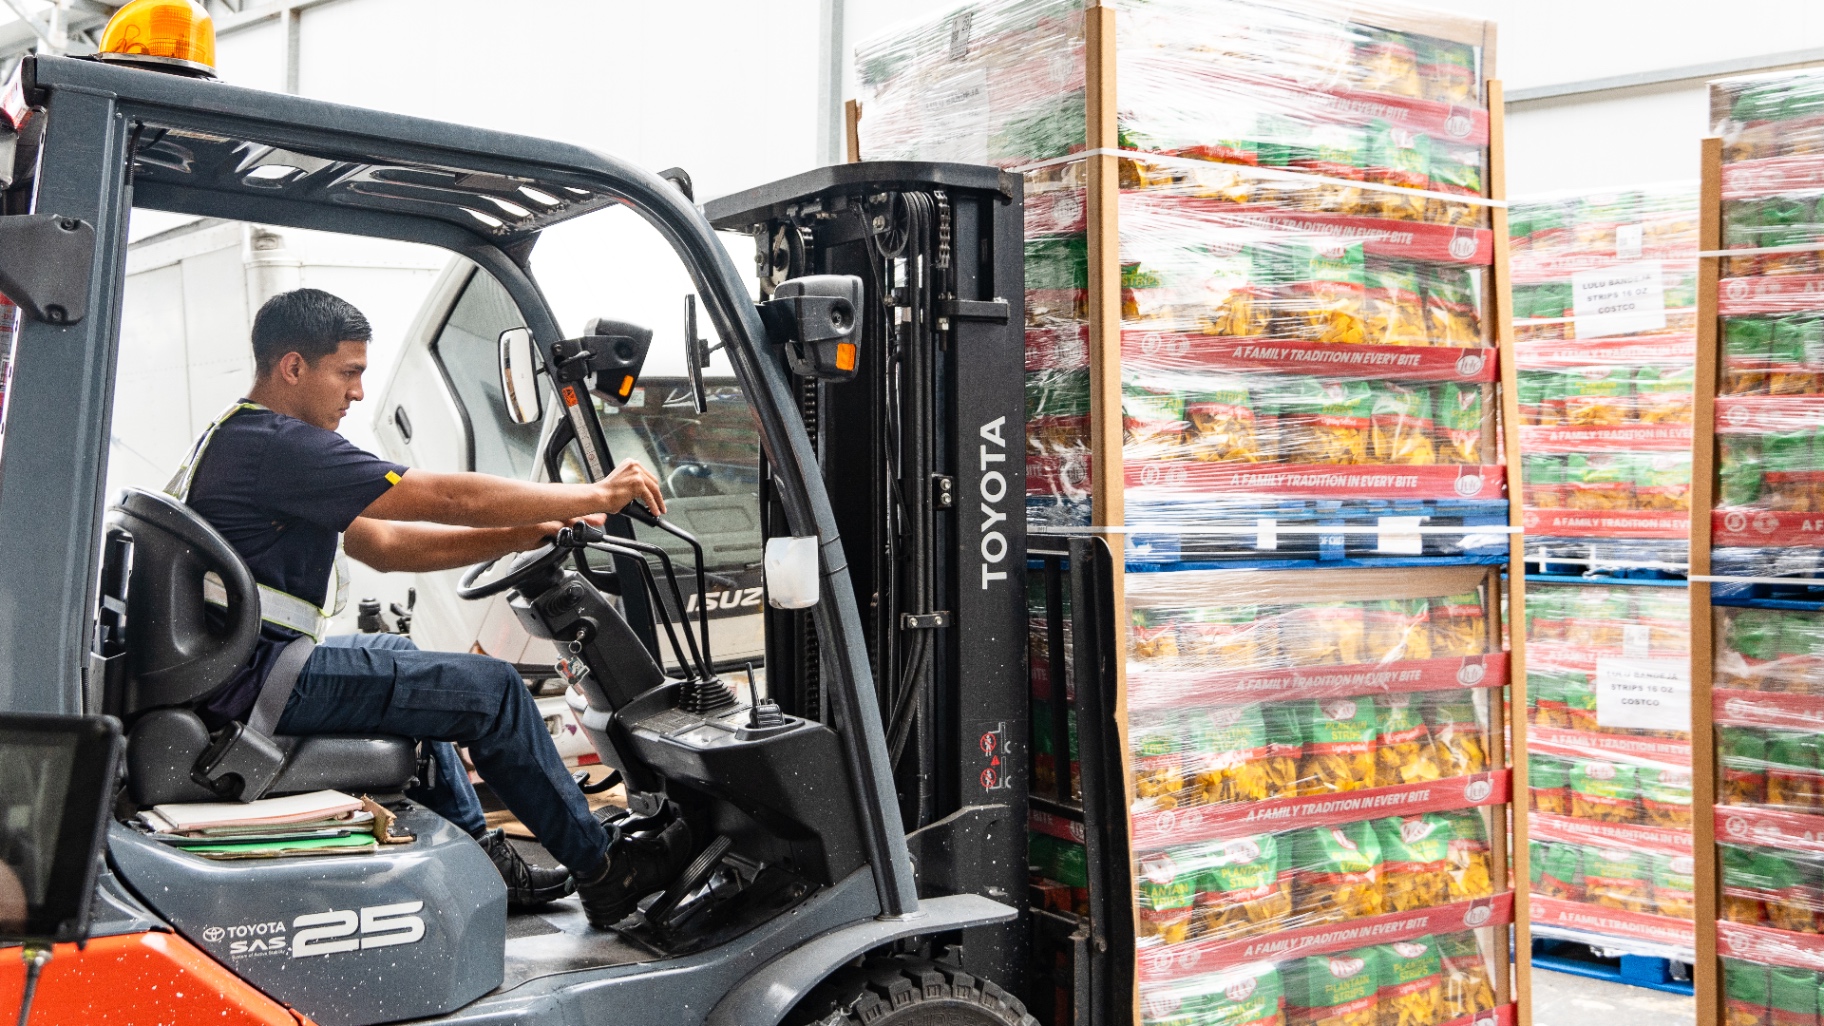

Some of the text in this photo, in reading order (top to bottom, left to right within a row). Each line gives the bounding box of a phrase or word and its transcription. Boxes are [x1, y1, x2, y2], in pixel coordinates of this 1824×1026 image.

[1281, 219, 1341, 236] TRADITION
[1341, 226, 1355, 237] IN
[1390, 231, 1413, 245] BITE
[1582, 282, 1606, 290] LULU
[1587, 292, 1619, 302] STRIPS
[1598, 303, 1635, 314] COSTCO
[1233, 346, 1421, 366] A FAMILY TRADITION IN EVERY BITE
[1559, 431, 1597, 440] FAMILY
[1599, 429, 1654, 439] TRADITION
[1656, 429, 1667, 438] IN
[1231, 474, 1418, 488] A FAMILY TRADITION IN EVERY BITE
[981, 416, 1008, 589] TOYOTA
[1553, 518, 1560, 526] A
[1561, 518, 1600, 527] FAMILY
[1601, 519, 1657, 528] TRADITION
[1659, 520, 1671, 528] IN
[1802, 520, 1813, 531] A
[686, 587, 763, 612] ISUZ
[1236, 669, 1421, 691] A FAMILY TRADITION IN EVERY BITE
[1621, 698, 1660, 706] COSTCO
[1560, 735, 1597, 746] FAMILY
[1599, 739, 1655, 751] TRADITION
[1246, 789, 1430, 822] A FAMILY TRADITION IN EVERY BITE
[1562, 822, 1600, 832] FAMILY
[1602, 825, 1658, 841] TRADITION
[228, 921, 286, 938] TOYOTA
[293, 901, 425, 958] 25
[1559, 912, 1567, 920] A
[1568, 913, 1605, 927] FAMILY
[1607, 920, 1664, 936] TRADITION
[230, 936, 286, 955] SAS
[1244, 916, 1429, 957] A FAMILY TRADITION IN EVERY BITE
[1325, 975, 1370, 994] PLANTAIN
[1333, 986, 1365, 1003] STRIPS
